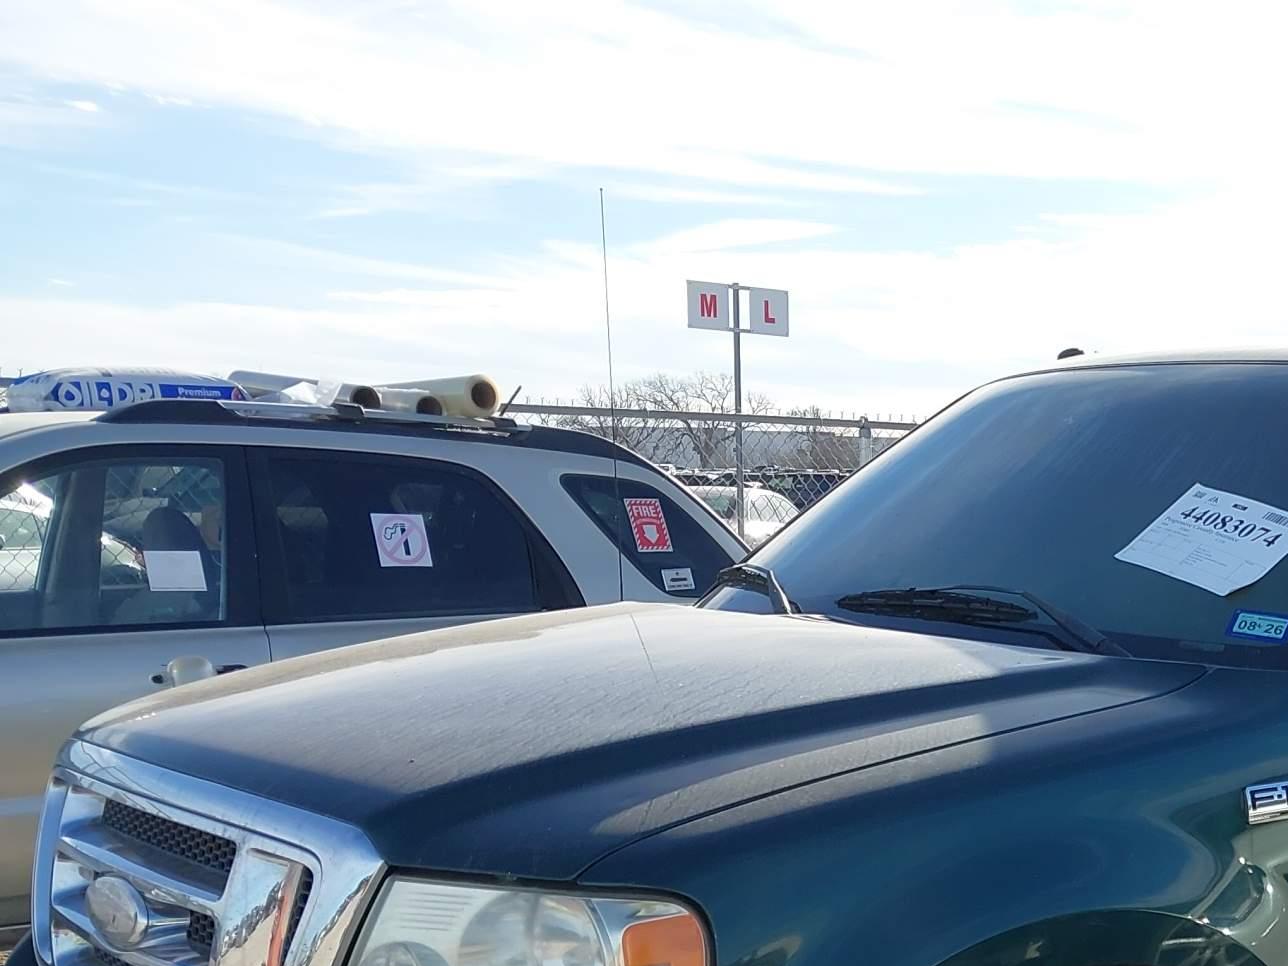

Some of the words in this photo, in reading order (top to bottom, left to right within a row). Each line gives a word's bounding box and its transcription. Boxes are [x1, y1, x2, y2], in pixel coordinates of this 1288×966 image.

[700, 293, 717, 318] M
[764, 300, 776, 324] L
[177, 386, 222, 398] Premium
[631, 505, 658, 518] FIRE
[1179, 505, 1283, 548] 44083074
[1238, 619, 1257, 632] 08
[1264, 623, 1285, 636] 26
